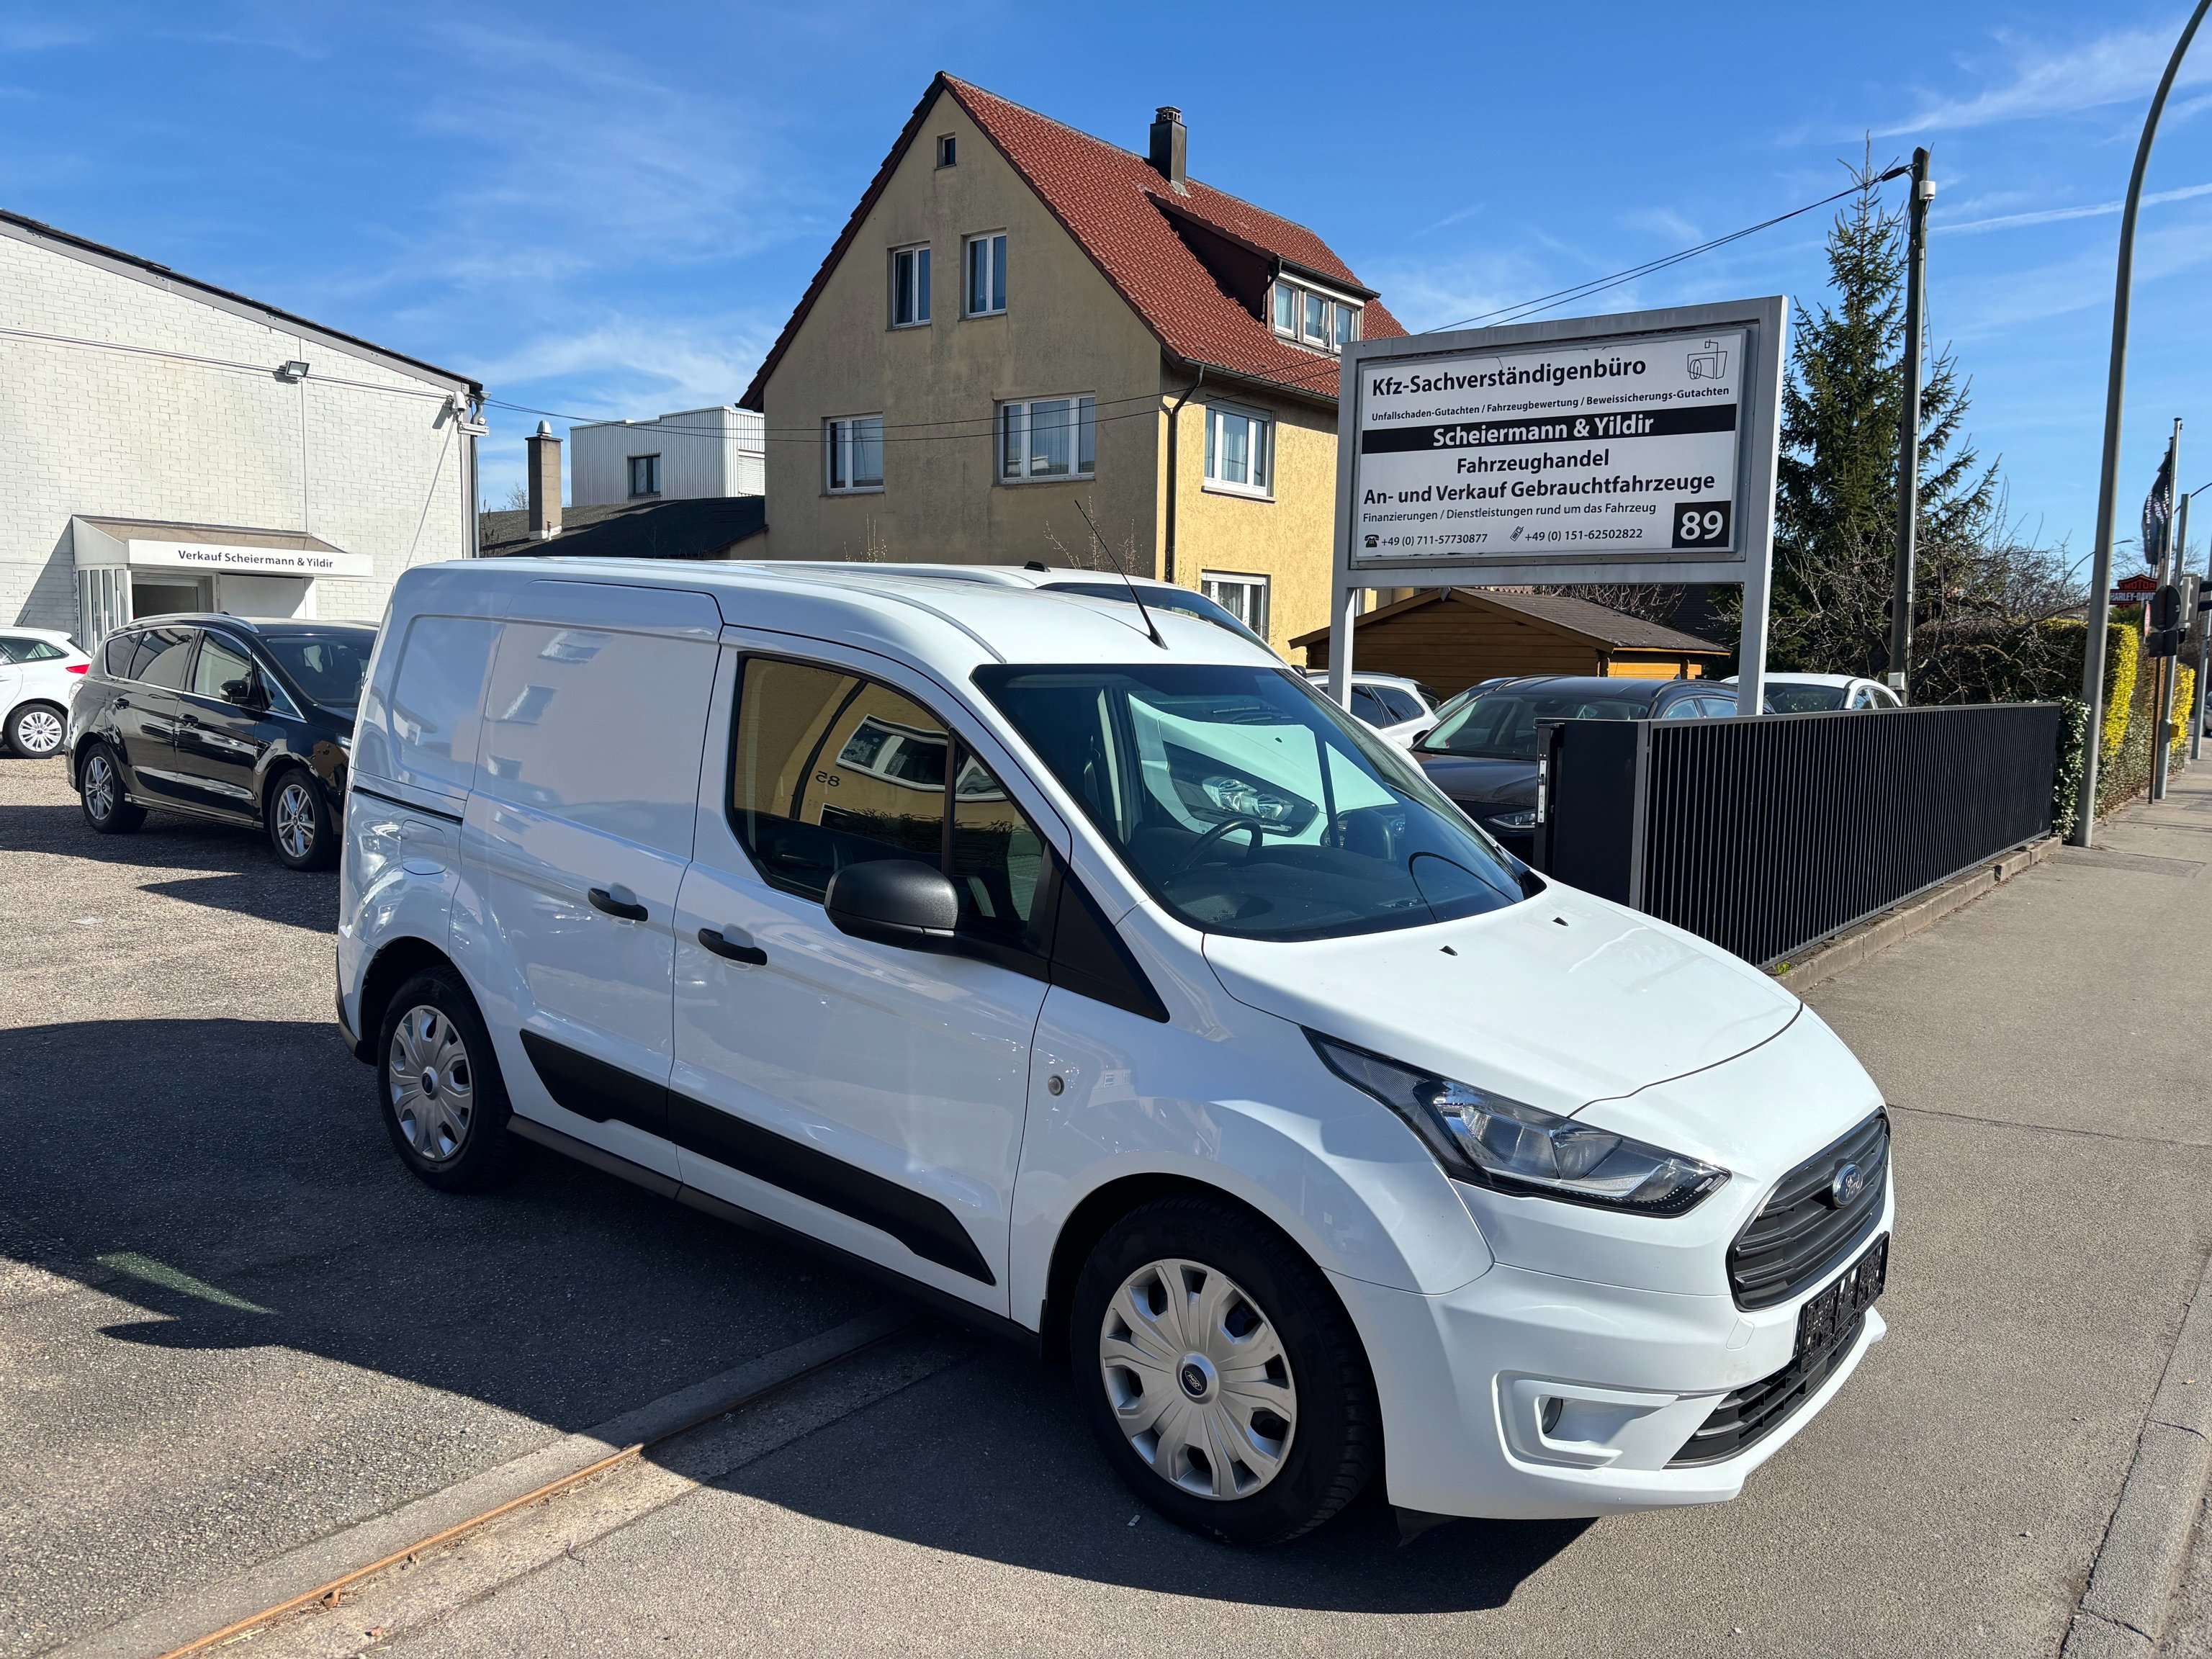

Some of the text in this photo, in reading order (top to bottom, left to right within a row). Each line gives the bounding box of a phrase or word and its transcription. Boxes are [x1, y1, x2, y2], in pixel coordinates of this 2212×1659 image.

[1372, 357, 1646, 397] Kfz-Sachverständigenbüro
[1372, 405, 1480, 421] Unfallschaden-Gutachten
[1487, 397, 1578, 413] Fahrzeugbewertung
[1586, 387, 1730, 405] Beweissicherungs-Gutachten
[1433, 414, 1654, 446] Scheiermann & Yildir
[1457, 449, 1609, 475] Fahrzeughandel
[1364, 475, 1715, 504] An- und Verkauf Gebrauchtfahrzeuge
[1363, 510, 1438, 522] Finanzierungen
[1447, 506, 1533, 519] Dienstleistungen
[1536, 504, 1561, 516] rund
[1564, 505, 1581, 514] um
[1584, 503, 1602, 514] das
[1605, 503, 1656, 515] Fahrzeug
[1680, 510, 1724, 540] 89
[1382, 534, 1488, 547] +49 (0) 711-57730877
[1525, 529, 1642, 541] +49 (0) 151-62502822
[179, 549, 333, 568] Verkauf Scheiermann & Yildir
